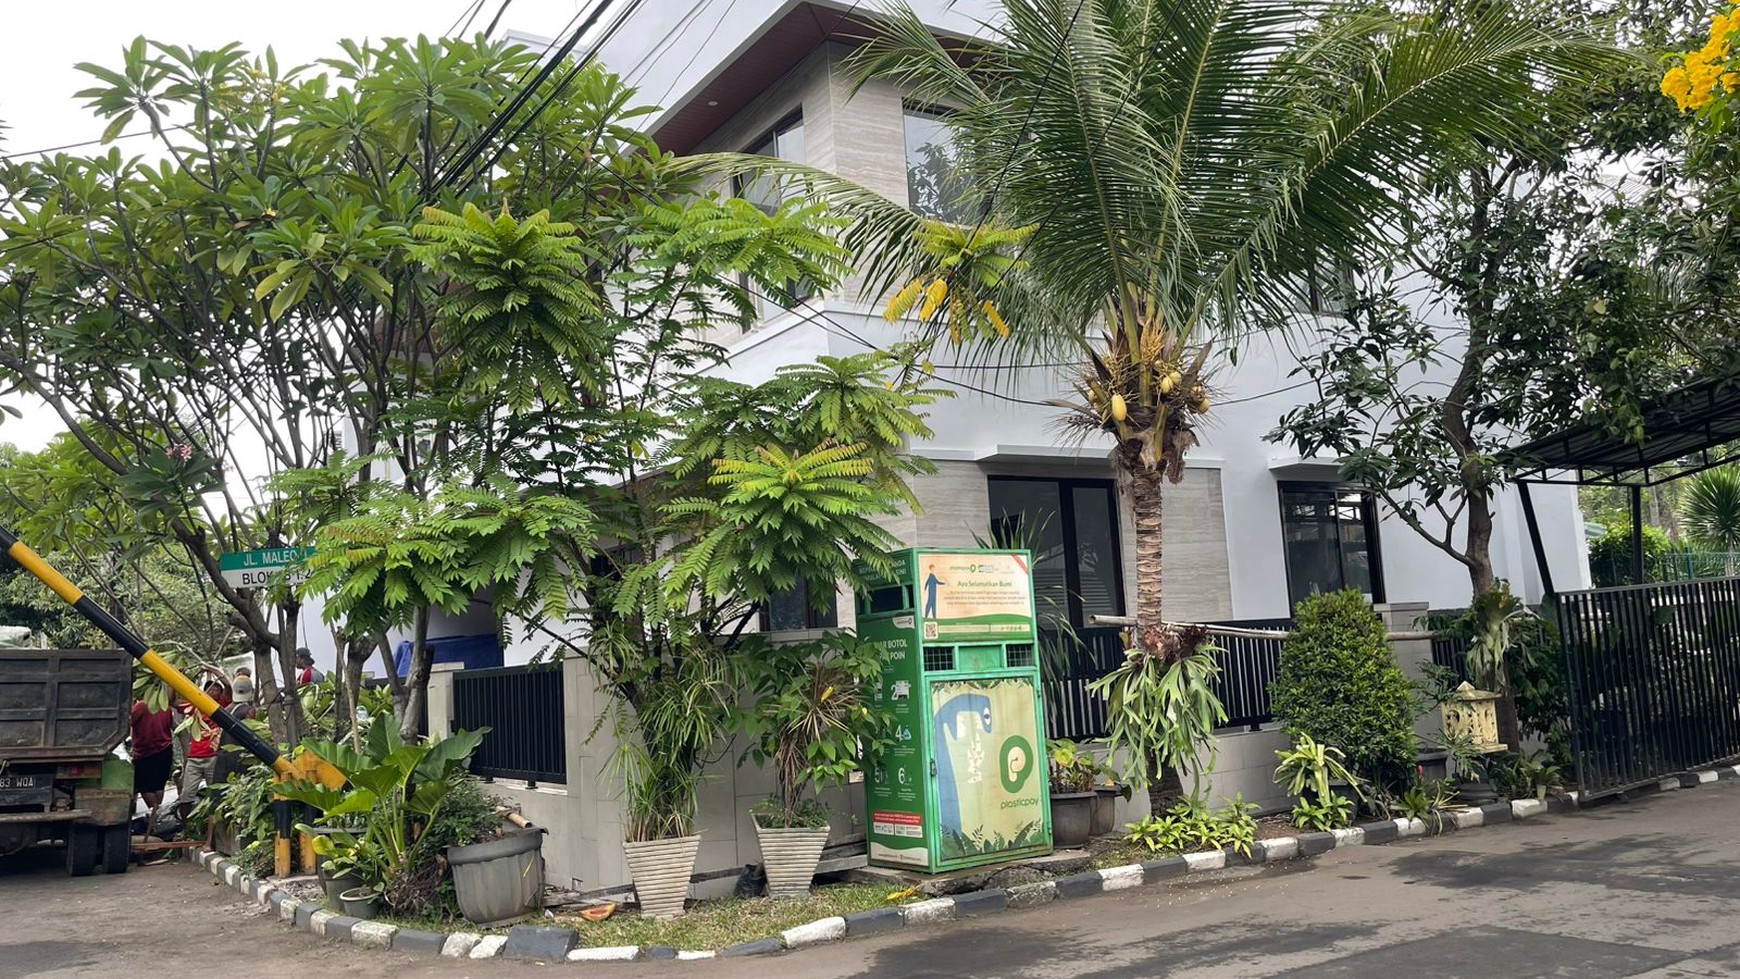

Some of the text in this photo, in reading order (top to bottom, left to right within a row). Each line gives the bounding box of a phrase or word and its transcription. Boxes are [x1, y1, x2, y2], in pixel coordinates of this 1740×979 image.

[243, 553, 258, 566] JL.
[262, 549, 297, 564] MALEO
[888, 639, 907, 648] BOTOL
[890, 651, 905, 660] POIN
[895, 724, 902, 742] 4
[898, 767, 905, 784] 6
[1000, 799, 1039, 810] plasticpay
